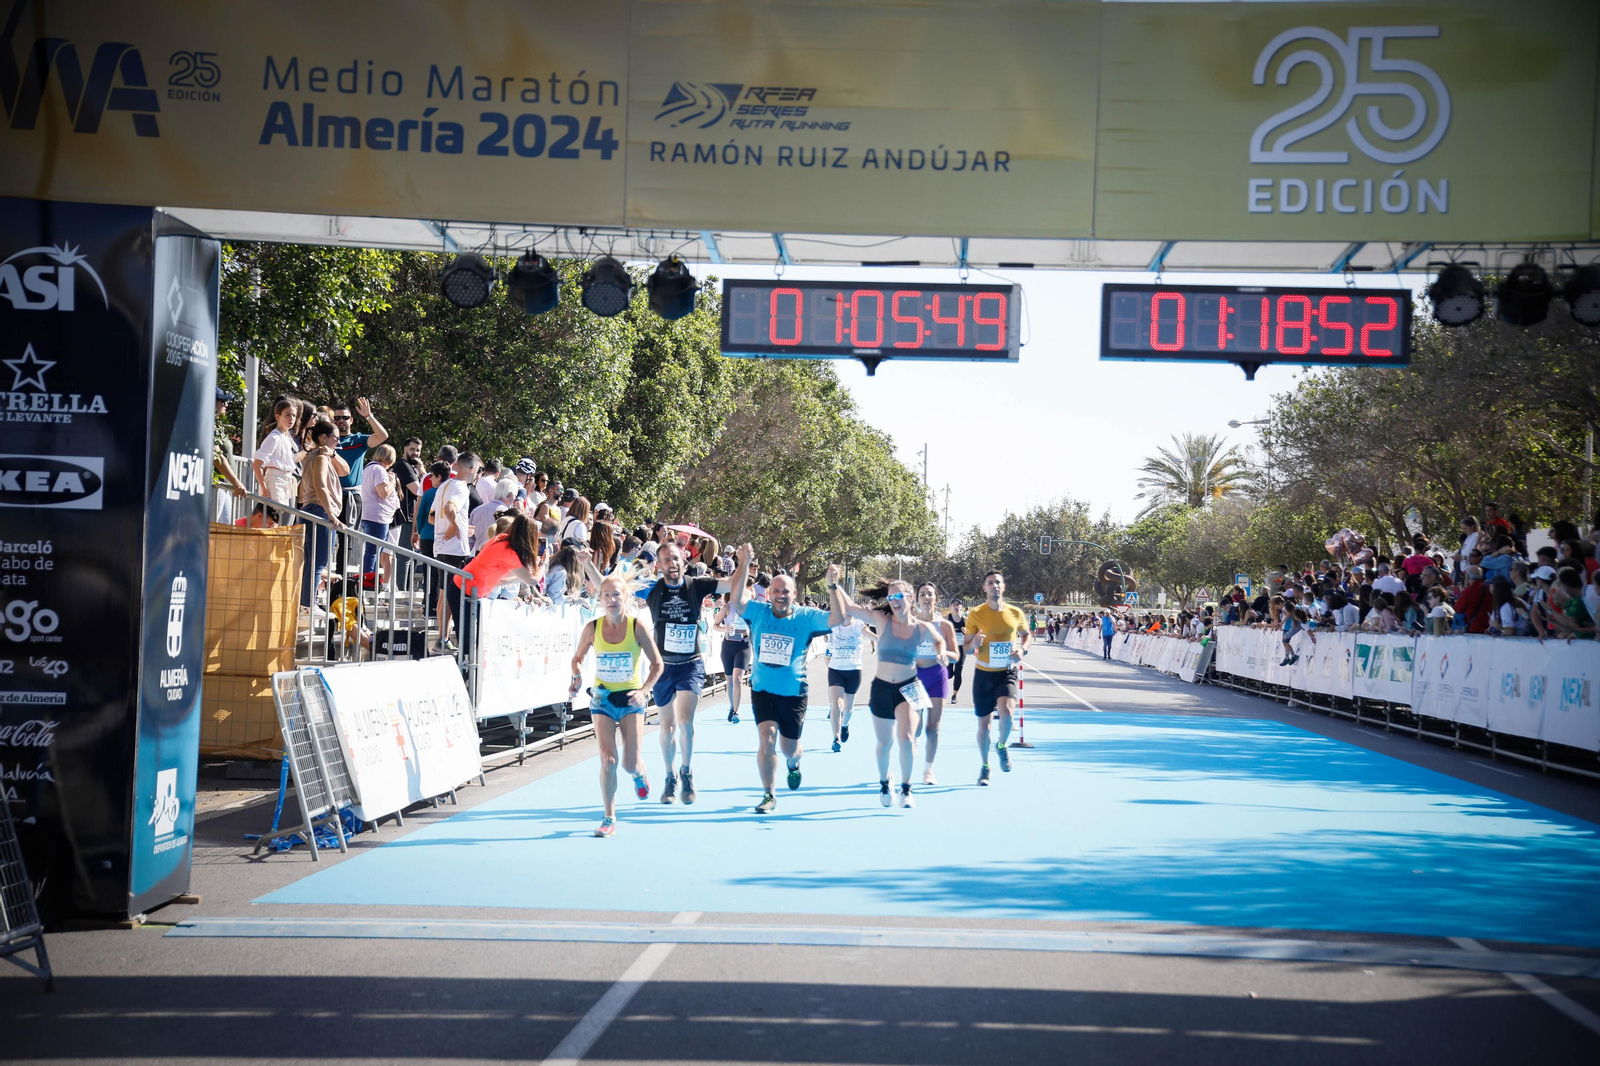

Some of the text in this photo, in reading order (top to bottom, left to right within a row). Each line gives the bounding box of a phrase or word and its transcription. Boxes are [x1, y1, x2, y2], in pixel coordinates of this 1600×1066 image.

[168, 50, 221, 88] 25
[262, 56, 621, 106] Medio Maratón
[167, 88, 221, 102] EDICIÓN
[743, 87, 817, 103] RFEA
[1249, 25, 1452, 165] 25
[736, 104, 809, 118] SERIES
[258, 101, 619, 160] Almería 2024
[729, 119, 851, 131] RUTA RUNNING
[650, 139, 1011, 172] RAMÓN RUIZ ANDÚJAR
[1247, 169, 1449, 214] EDICIÓN
[769, 287, 1008, 352] 01:05:49
[1149, 290, 1398, 358] 01:18:52
[6, 412, 72, 424] LEVANTE
[1, 555, 54, 570] abo de
[2, 573, 27, 585] ata
[30, 635, 44, 643] sport
[669, 630, 694, 639] 5910
[382, 642, 407, 651] PMA
[764, 640, 790, 650] 5907
[993, 646, 1013, 655] 586
[600, 658, 629, 667] 5782
[160, 664, 189, 688] ALMERÍA
[7, 693, 20, 702] de
[21, 694, 64, 703] Almería
